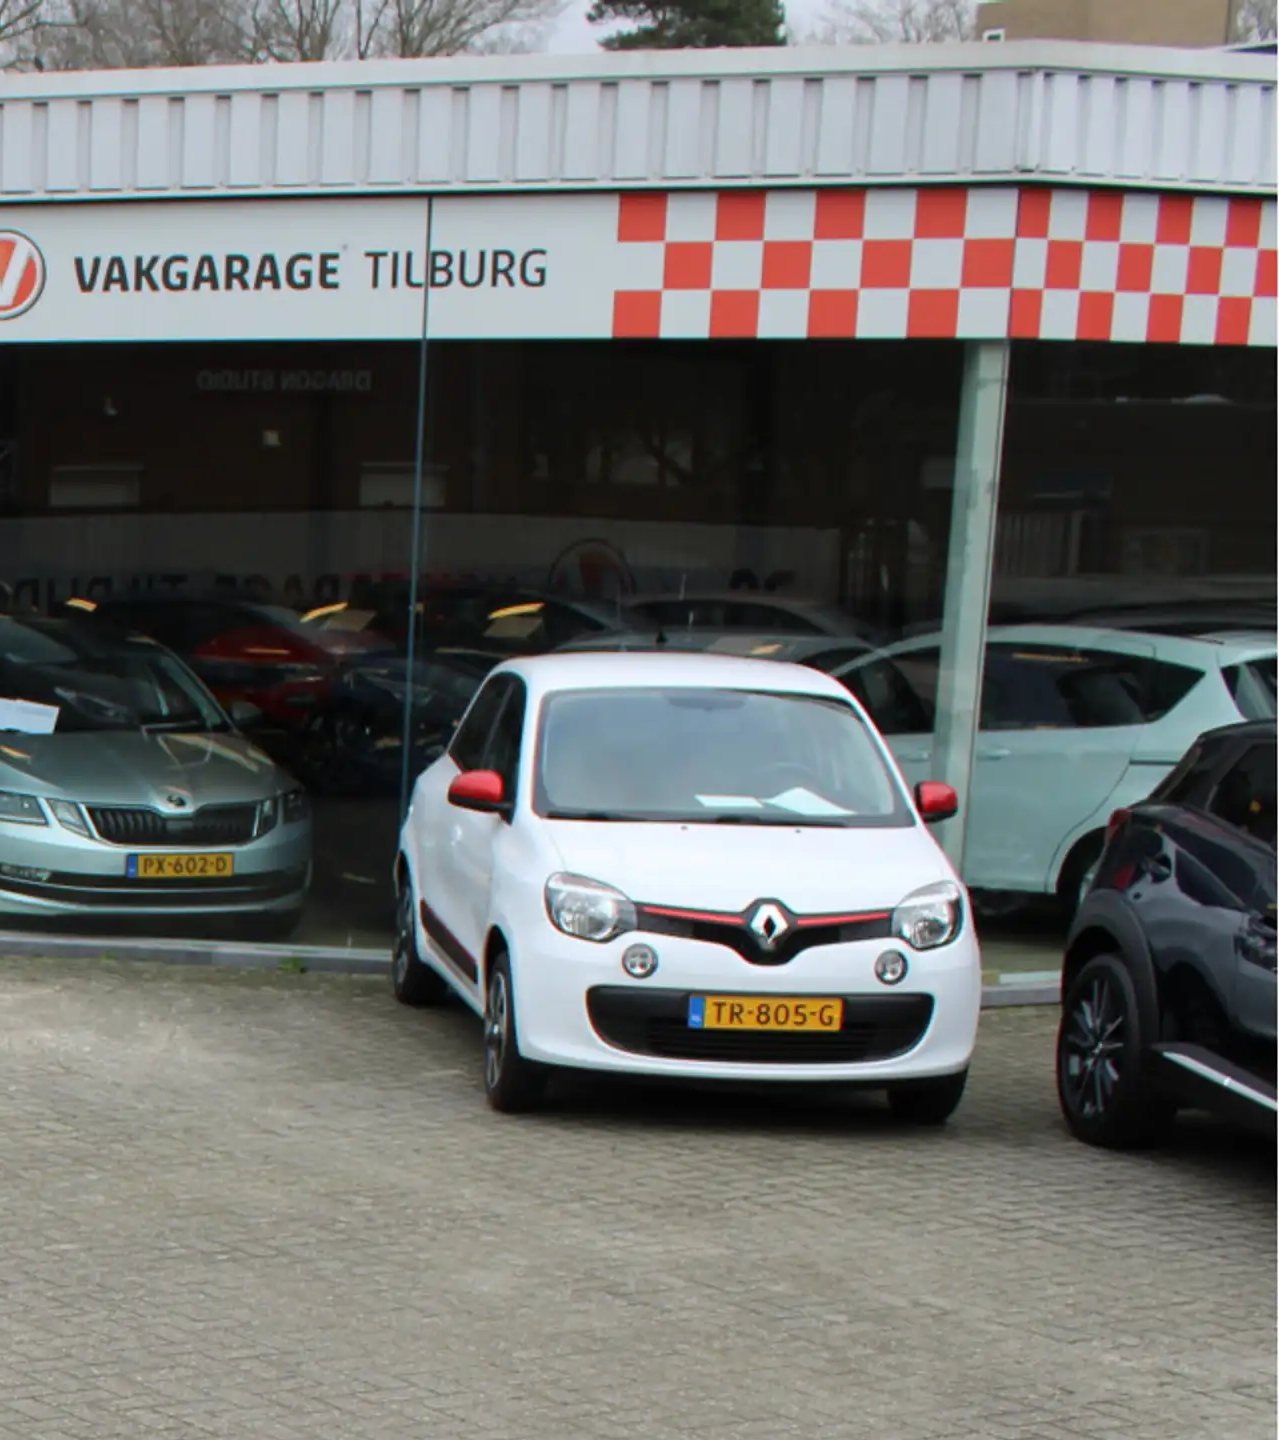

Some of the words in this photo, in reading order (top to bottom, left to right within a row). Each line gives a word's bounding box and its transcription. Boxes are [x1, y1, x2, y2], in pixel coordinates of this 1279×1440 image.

[74, 252, 341, 293] VAKGARAGE
[364, 249, 548, 289] TILBURG
[143, 855, 227, 874] PX-602-D
[713, 1001, 835, 1027] TR-805-G
